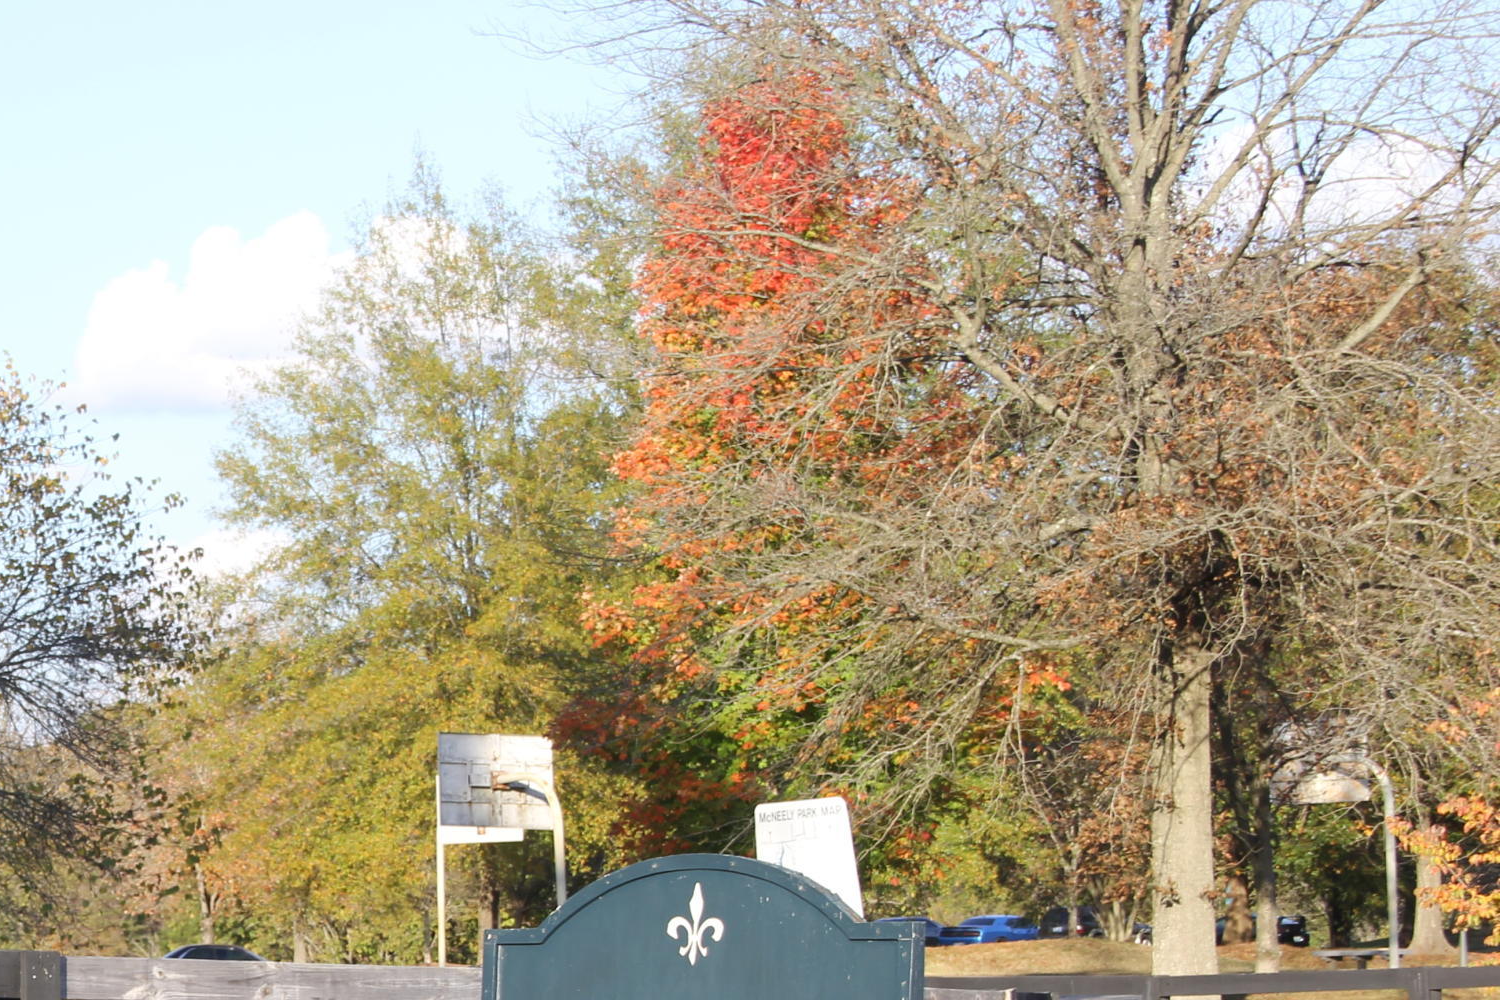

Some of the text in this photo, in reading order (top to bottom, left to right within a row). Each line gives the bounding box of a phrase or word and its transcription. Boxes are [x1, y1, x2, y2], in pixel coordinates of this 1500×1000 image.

[759, 804, 841, 823] McNEELY PARK MAP
